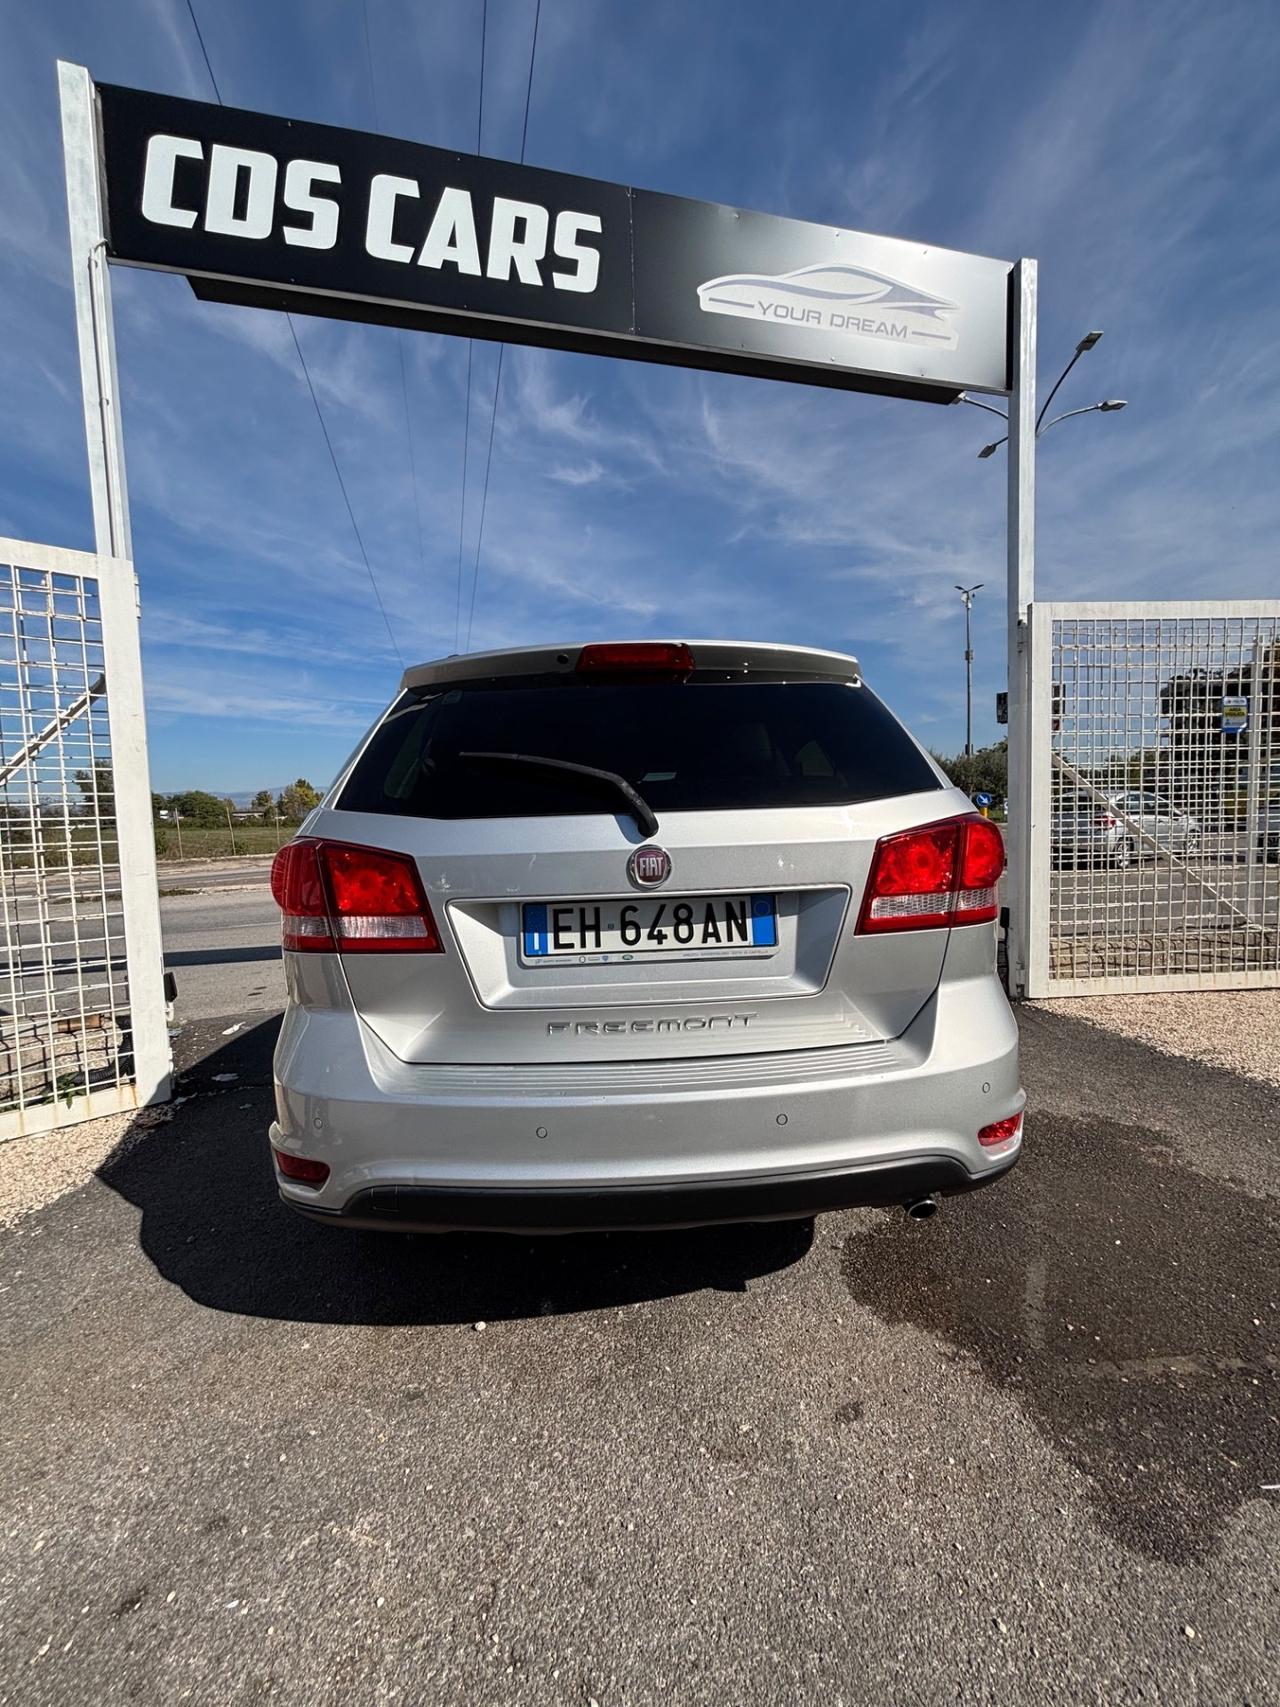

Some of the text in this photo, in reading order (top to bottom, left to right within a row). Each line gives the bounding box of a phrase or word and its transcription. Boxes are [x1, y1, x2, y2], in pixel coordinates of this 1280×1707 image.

[142, 134, 602, 294] CDS CARS
[758, 301, 908, 338] YOUR DREAM
[639, 856, 664, 877] FIAT
[553, 901, 748, 949] EH 648AN
[547, 1012, 758, 1036] FREEMONT
